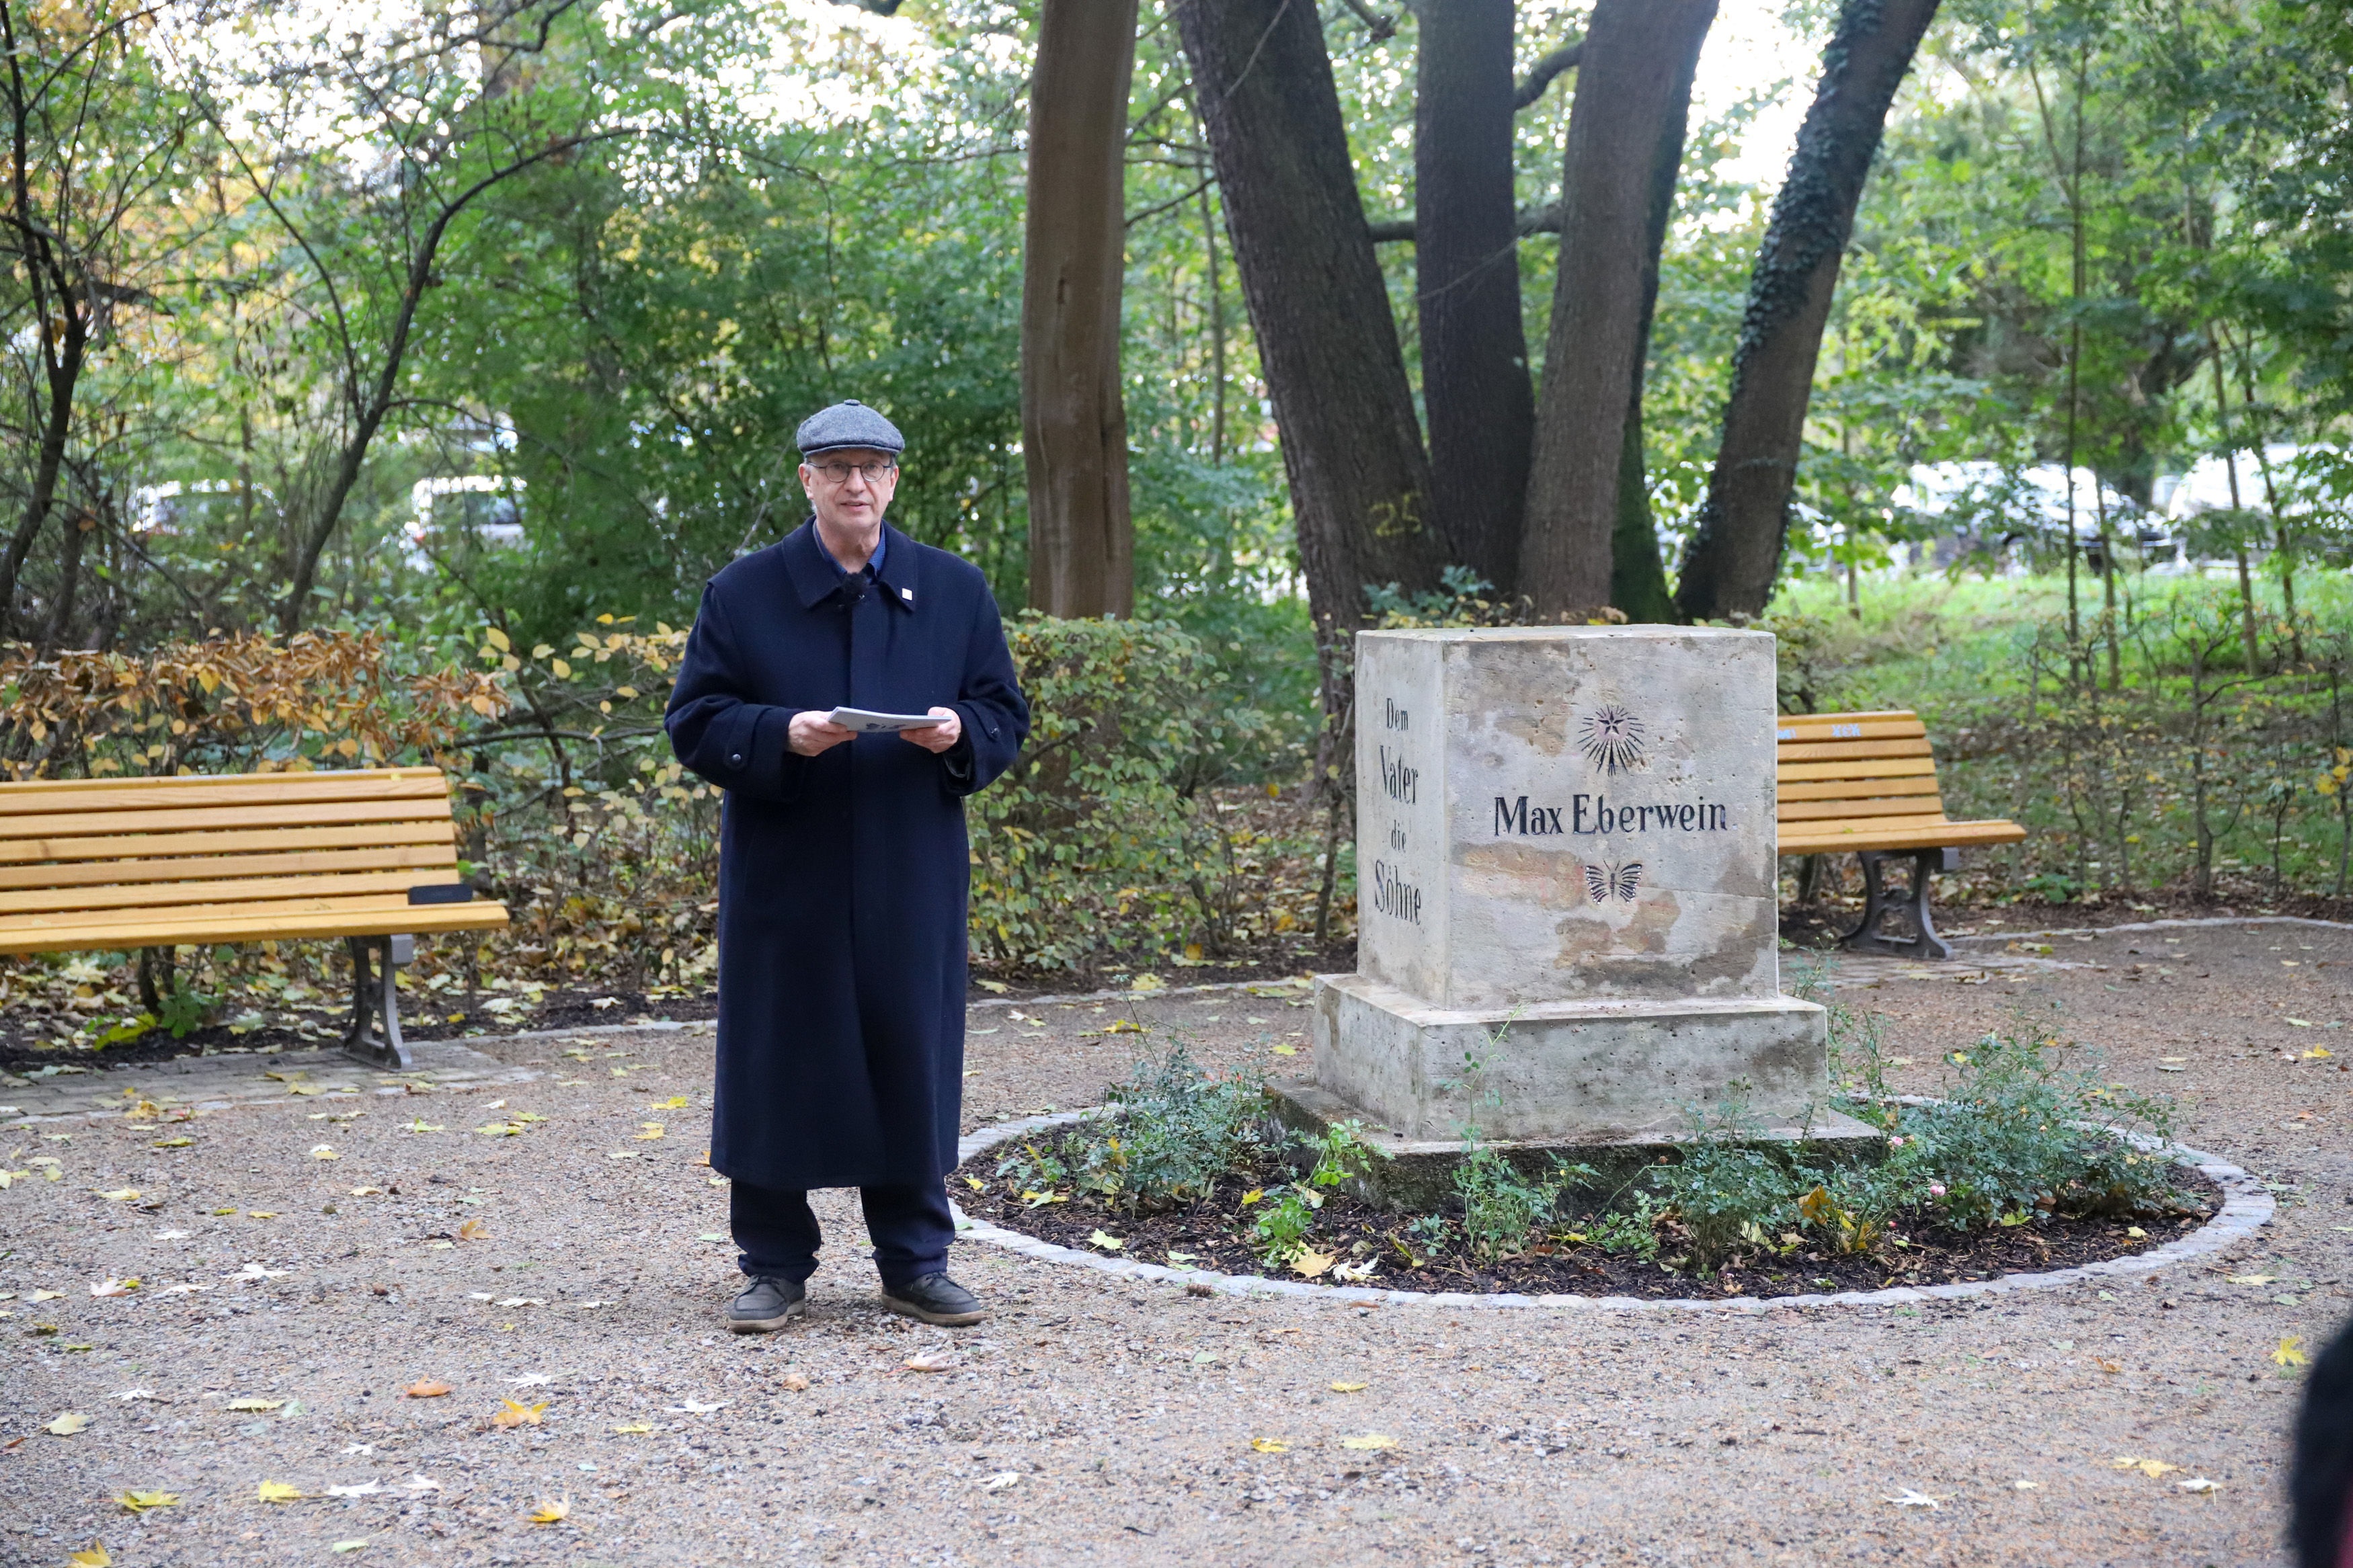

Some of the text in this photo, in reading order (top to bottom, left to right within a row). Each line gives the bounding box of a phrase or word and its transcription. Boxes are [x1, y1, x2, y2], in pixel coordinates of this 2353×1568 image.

[1369, 490, 1423, 537] 25
[1386, 698, 1408, 731] Dem
[1380, 745, 1419, 805] Vater
[1391, 819, 1407, 854] die
[1494, 793, 1728, 837] Max Eberwein
[1375, 859, 1421, 925] Söhne
